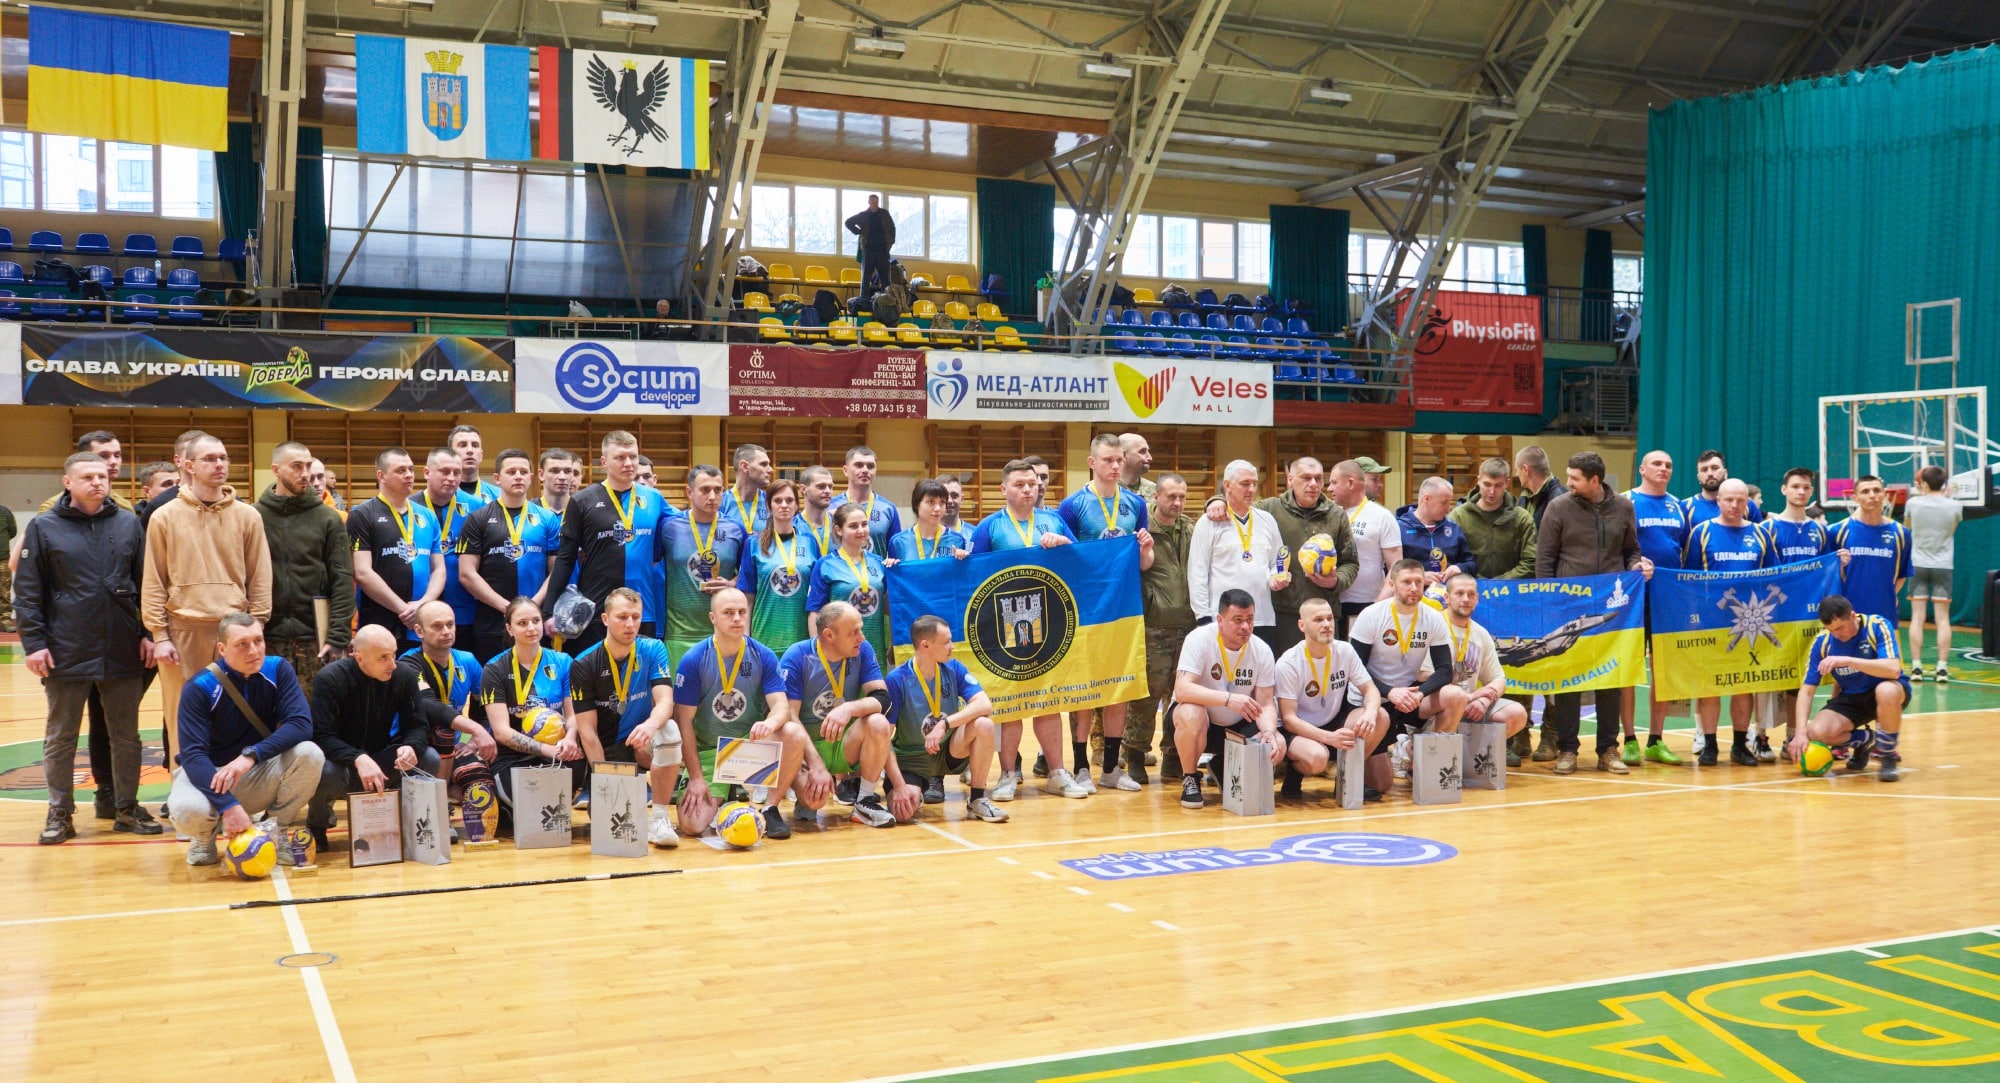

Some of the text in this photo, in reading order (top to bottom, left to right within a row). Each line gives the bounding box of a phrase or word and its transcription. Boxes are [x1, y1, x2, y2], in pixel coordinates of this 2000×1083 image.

[1452, 320, 1536, 343] PhysioFit
[1506, 343, 1536, 351] center
[26, 359, 240, 377] СЛАВА УКРАЇНІ!
[248, 364, 311, 387] ГОВЕРЛА
[319, 366, 509, 382] ГЕРОЯМ СЛАВА!
[738, 370, 776, 379] OPTIMA
[582, 363, 696, 390] Socium
[976, 375, 1108, 395] МЕД-АТЛАНТ
[1190, 376, 1267, 399] Veles
[640, 391, 696, 407] developer
[978, 400, 1081, 409] лікувально-діагностичний
[845, 404, 860, 412] +38
[862, 404, 877, 412] 067
[879, 404, 894, 413] 343
[906, 405, 917, 413] 82
[1192, 404, 1233, 412] MALL
[1781, 561, 1822, 574] БРИГАДА
[1482, 582, 1593, 599] 114 БРИГАДА
[1690, 614, 1700, 624] ЗІ
[1676, 637, 1716, 649] ЩИТОМ
[1235, 668, 1252, 677] 649
[1330, 670, 1345, 681] 649
[1505, 657, 1618, 691] ИЧНОЇ АВІАЦІЇ
[1715, 665, 1798, 687] ЕДЕЛЬВЕЙС
[1050, 683, 1087, 694] Семена
[1024, 696, 1060, 710] Гвардії
[1063, 692, 1101, 704] України
